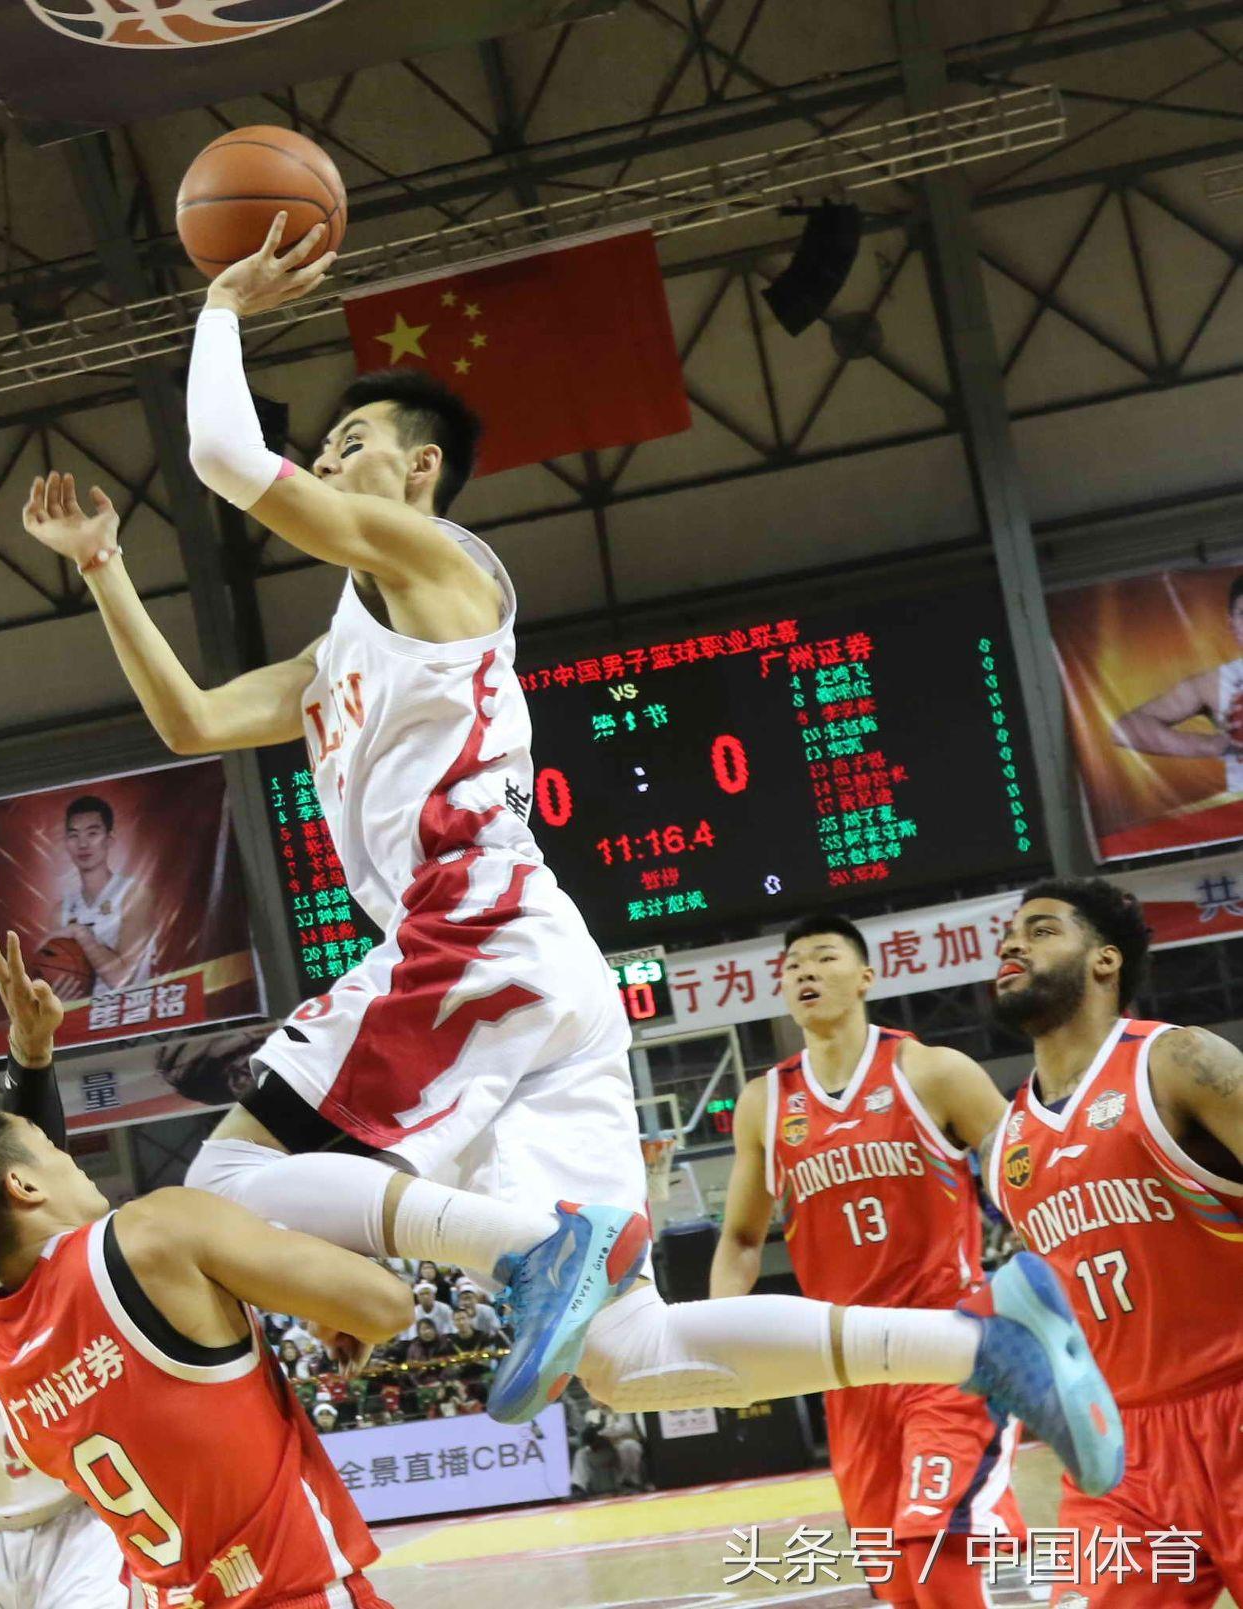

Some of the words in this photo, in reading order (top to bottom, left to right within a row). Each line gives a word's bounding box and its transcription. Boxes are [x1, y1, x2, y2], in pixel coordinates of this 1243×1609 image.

[760, 632, 874, 679] 广州证券
[535, 767, 573, 828] 0
[711, 734, 749, 794] 0
[596, 819, 715, 866] 11:16.4
[789, 1139, 925, 1203] LONGLIONS
[842, 1196, 889, 1247] 13
[1075, 1250, 1134, 1322] 17
[8, 1333, 126, 1442] 广州证券
[338, 1438, 546, 1491] 全景直播CBA
[909, 1454, 953, 1502] 13
[72, 1432, 184, 1568] 9
